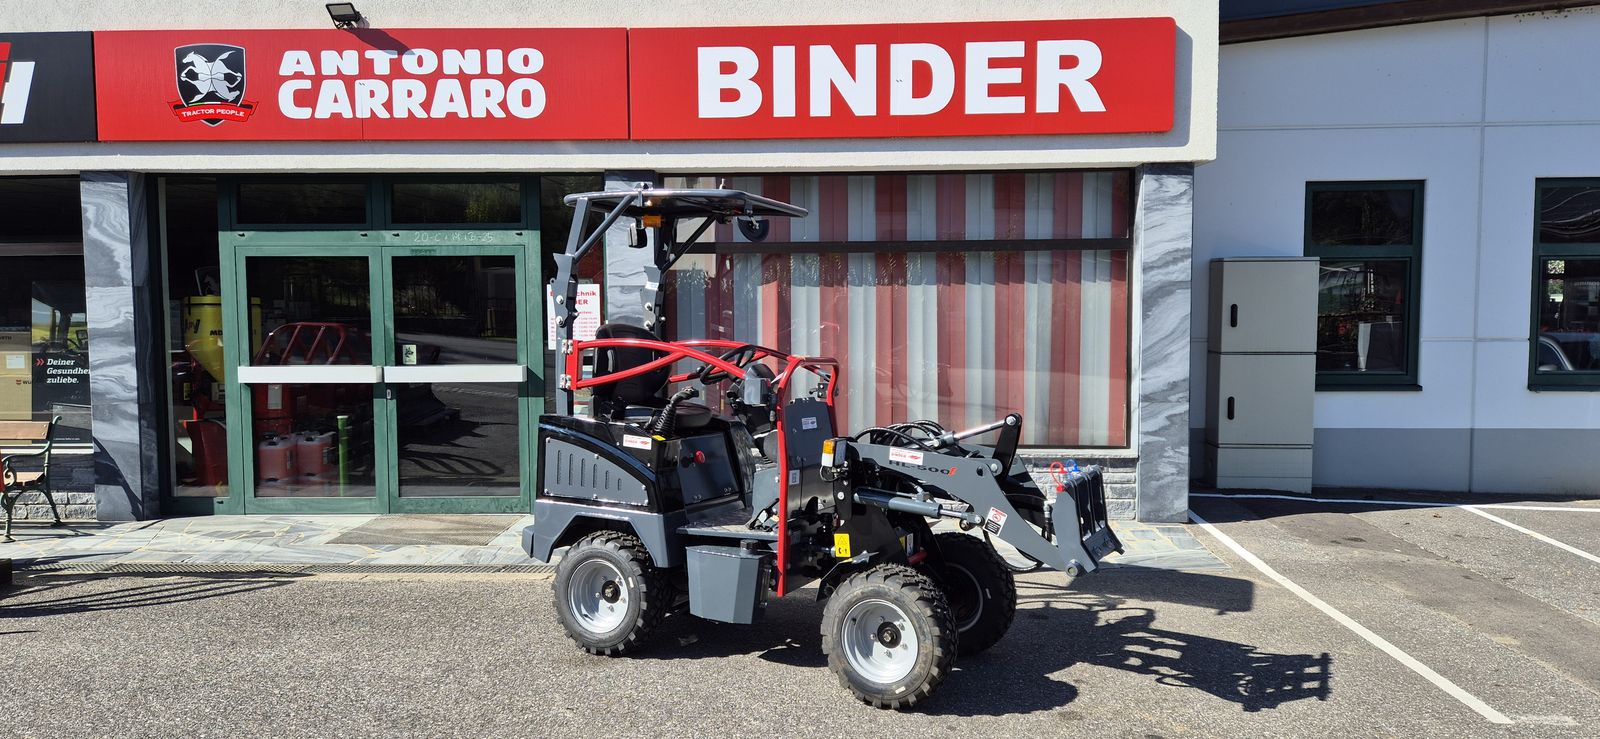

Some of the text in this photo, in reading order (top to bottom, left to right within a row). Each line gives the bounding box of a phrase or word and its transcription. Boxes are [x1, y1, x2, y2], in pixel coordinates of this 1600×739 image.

[279, 48, 544, 75] ANTONIO
[697, 39, 1107, 118] BINDER
[278, 78, 546, 119] CARRARO
[181, 108, 245, 117] TRACTOR PEOPLE
[46, 358, 76, 366] Deiner
[46, 367, 90, 375] Gesundhe
[46, 376, 80, 384] zuliebe.
